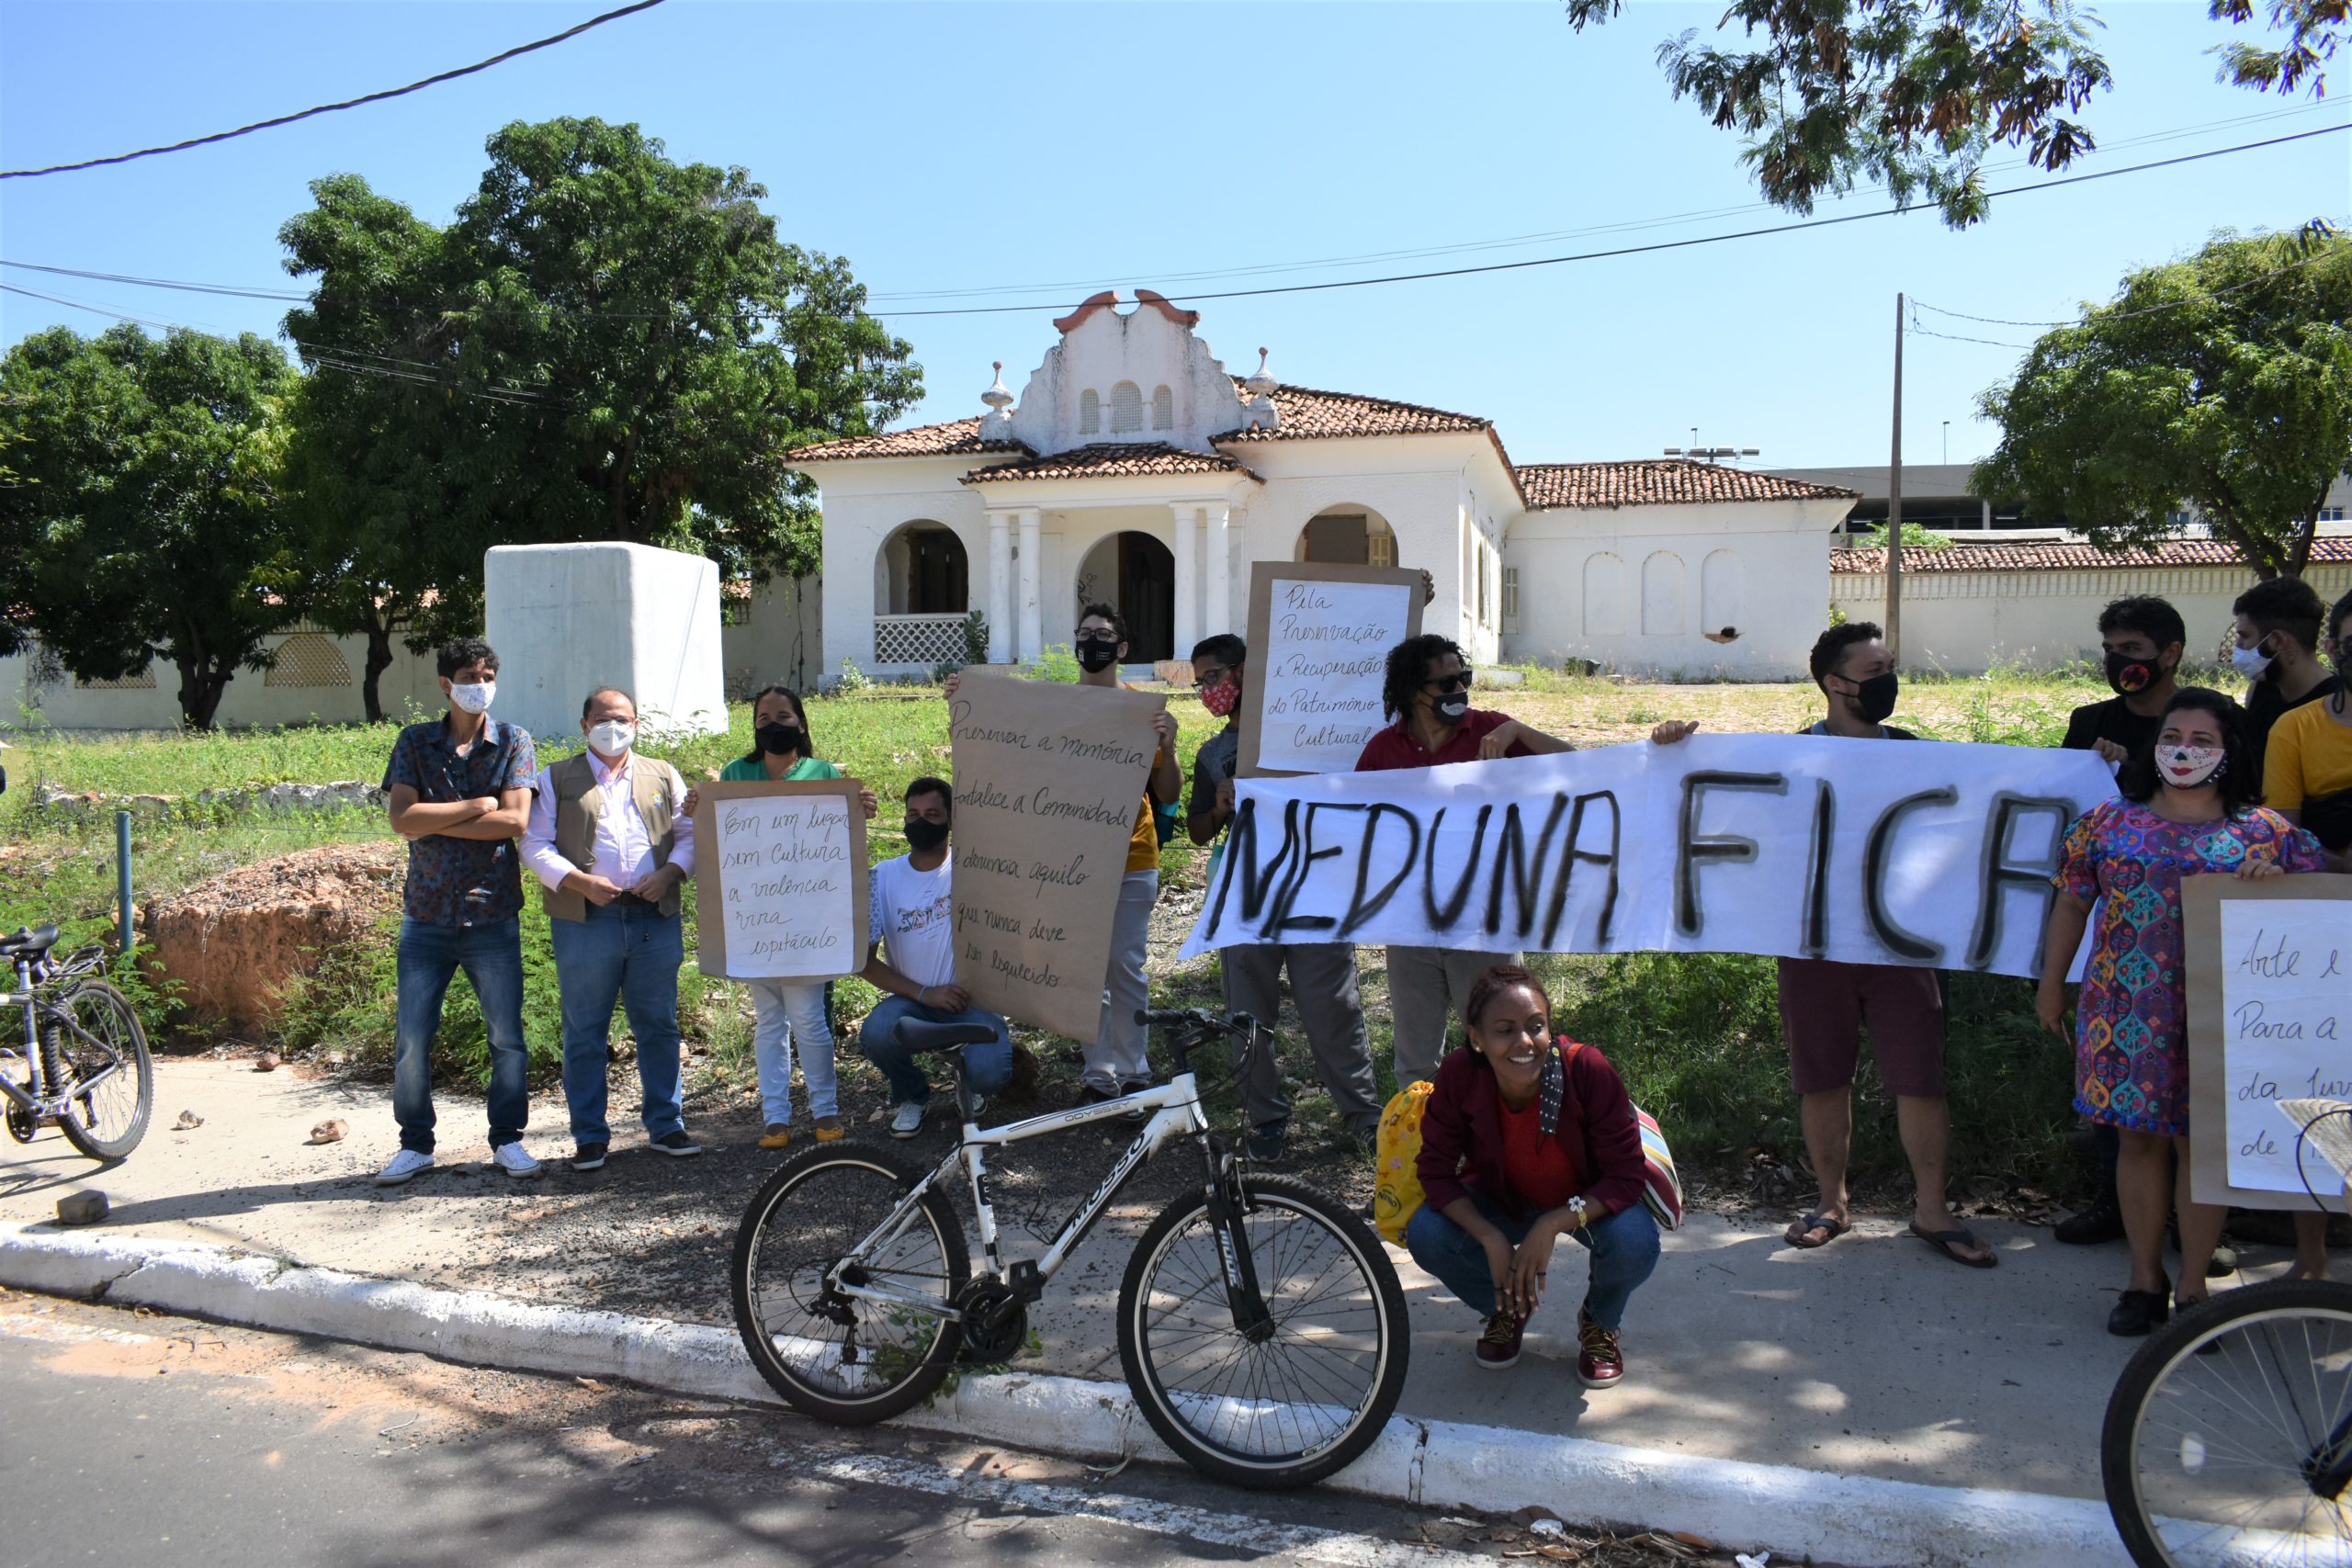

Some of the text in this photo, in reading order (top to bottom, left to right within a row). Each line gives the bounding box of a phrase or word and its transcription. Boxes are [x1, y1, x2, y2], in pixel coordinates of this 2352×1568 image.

[1285, 584, 1333, 610] Pela
[1279, 614, 1389, 644] Preservação
[1272, 653, 1383, 682] e Recuperação
[1268, 697, 1286, 715] do
[950, 700, 1030, 750] Preservar
[1037, 736, 1054, 752] a
[1294, 723, 1372, 748] Cultural
[954, 771, 1129, 829] fortalece a Comunidade
[724, 805, 851, 843] Em um lugar
[721, 840, 847, 869] sem Cultura
[963, 846, 1020, 879] denuncia
[1028, 854, 1091, 898] aquilo
[1204, 769, 2079, 975] NEDUNA FICA
[729, 874, 838, 902] a violência
[736, 910, 793, 930] vira
[957, 901, 979, 931] que
[984, 908, 1022, 936] nunca
[1029, 918, 1067, 942] deve
[966, 942, 1061, 990] ser esquecido
[2236, 929, 2343, 978] Arte e
[2233, 1000, 2338, 1040] Para a
[2238, 1072, 2282, 1100] da
[1064, 1100, 1131, 1122] ODYSSEY
[2241, 1130, 2278, 1157] de
[1070, 1132, 1146, 1228] MOSSO
